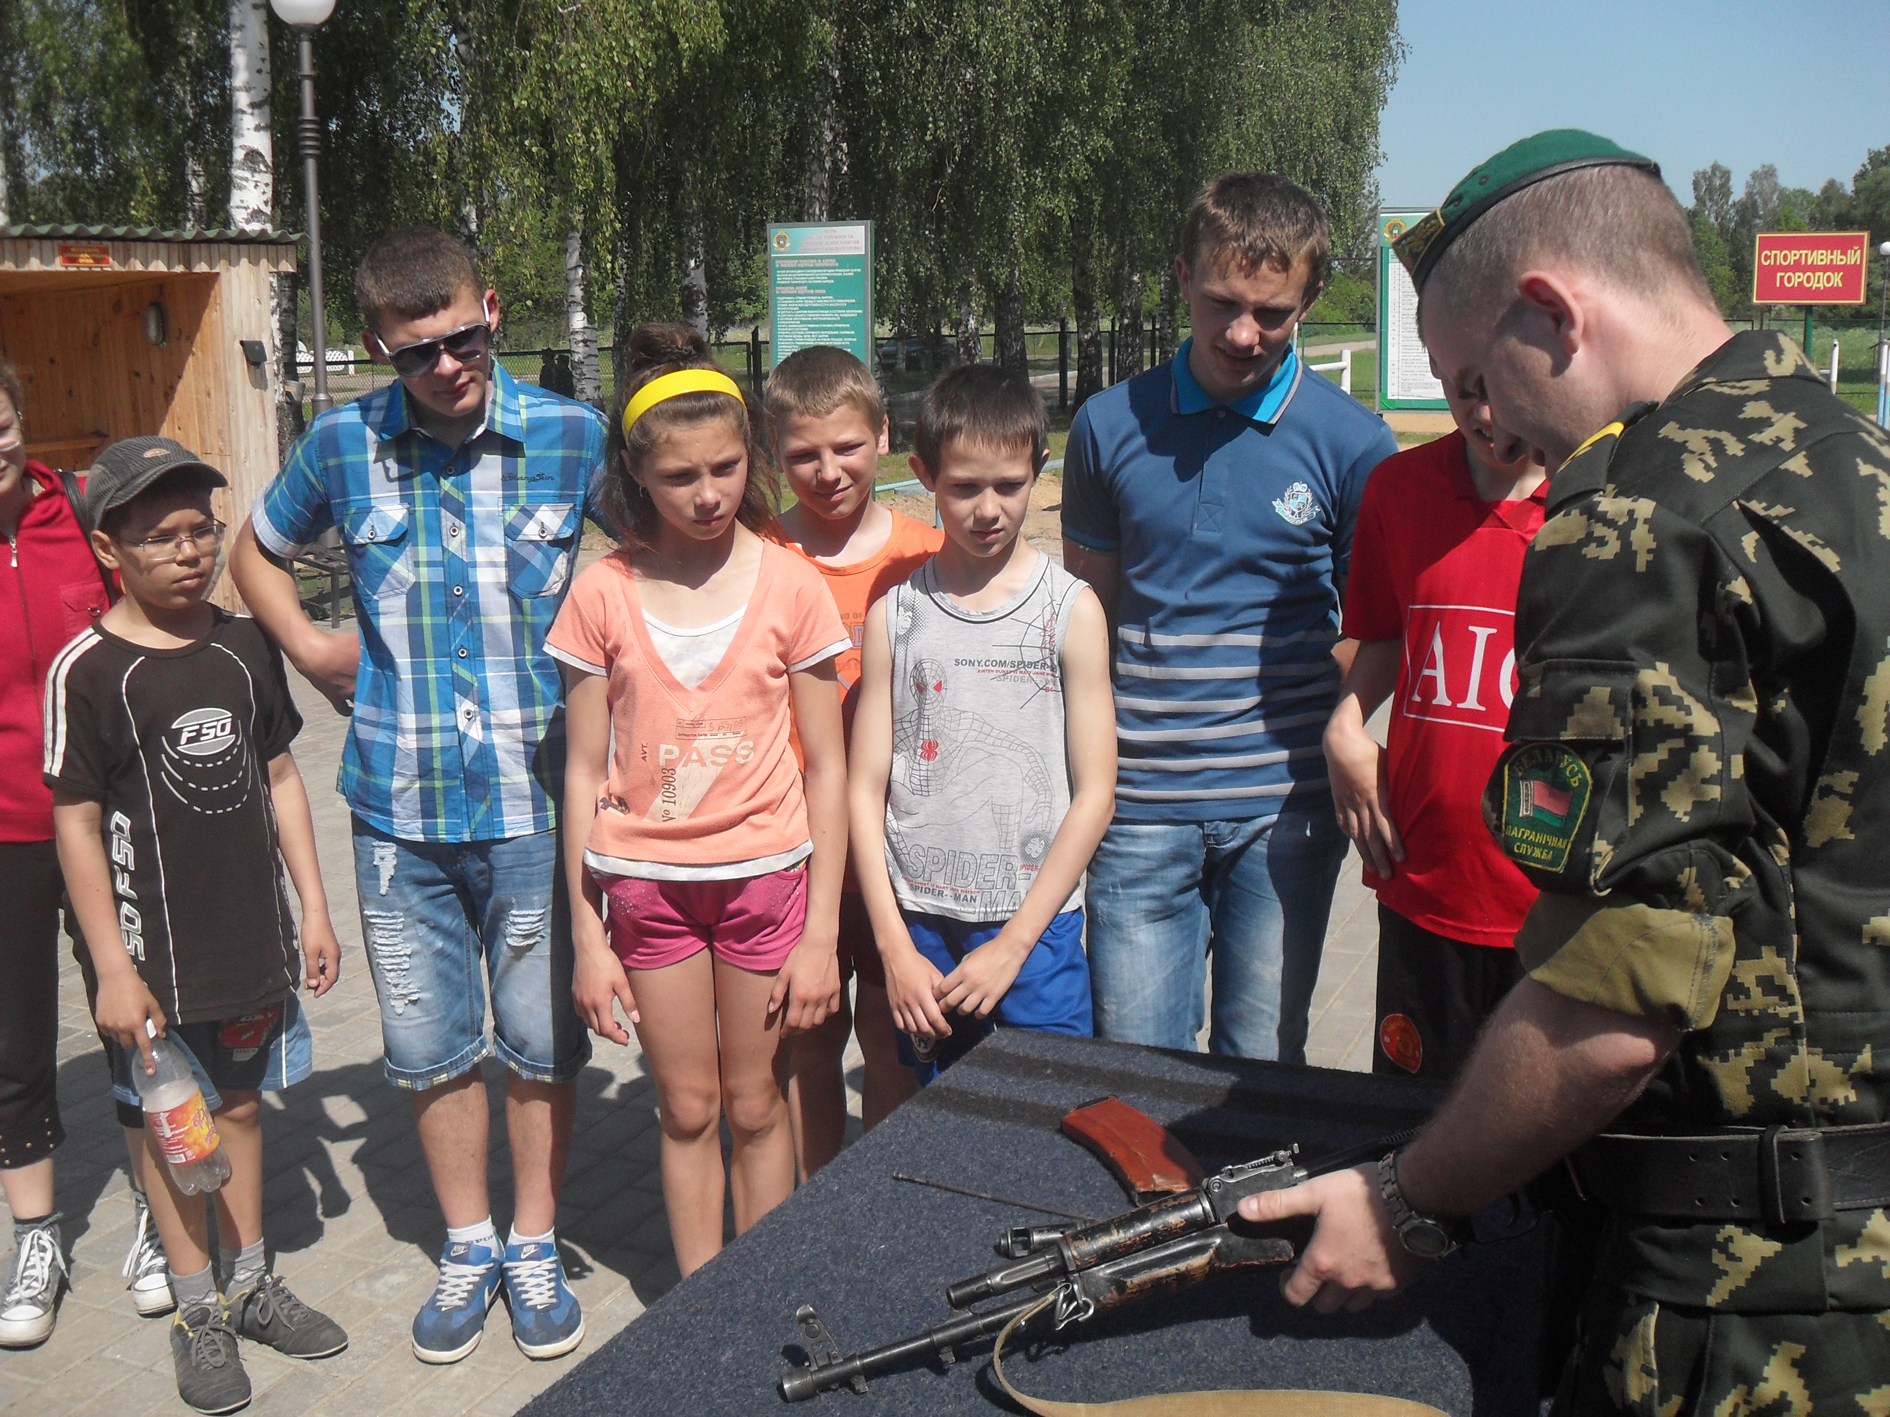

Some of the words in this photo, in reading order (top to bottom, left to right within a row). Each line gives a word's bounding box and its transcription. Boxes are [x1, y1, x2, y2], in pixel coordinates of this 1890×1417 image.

[1761, 246, 1861, 266] СПОРТИВНЫЙ
[1776, 272, 1844, 290] ГОРОДОК
[180, 717, 232, 746] FSO
[658, 740, 755, 768] PASS
[661, 767, 677, 807] 10903
[110, 811, 138, 900] FSO
[1514, 842, 1553, 861] СЛУЖБА
[978, 890, 1028, 922] MA
[120, 901, 146, 983] SO
